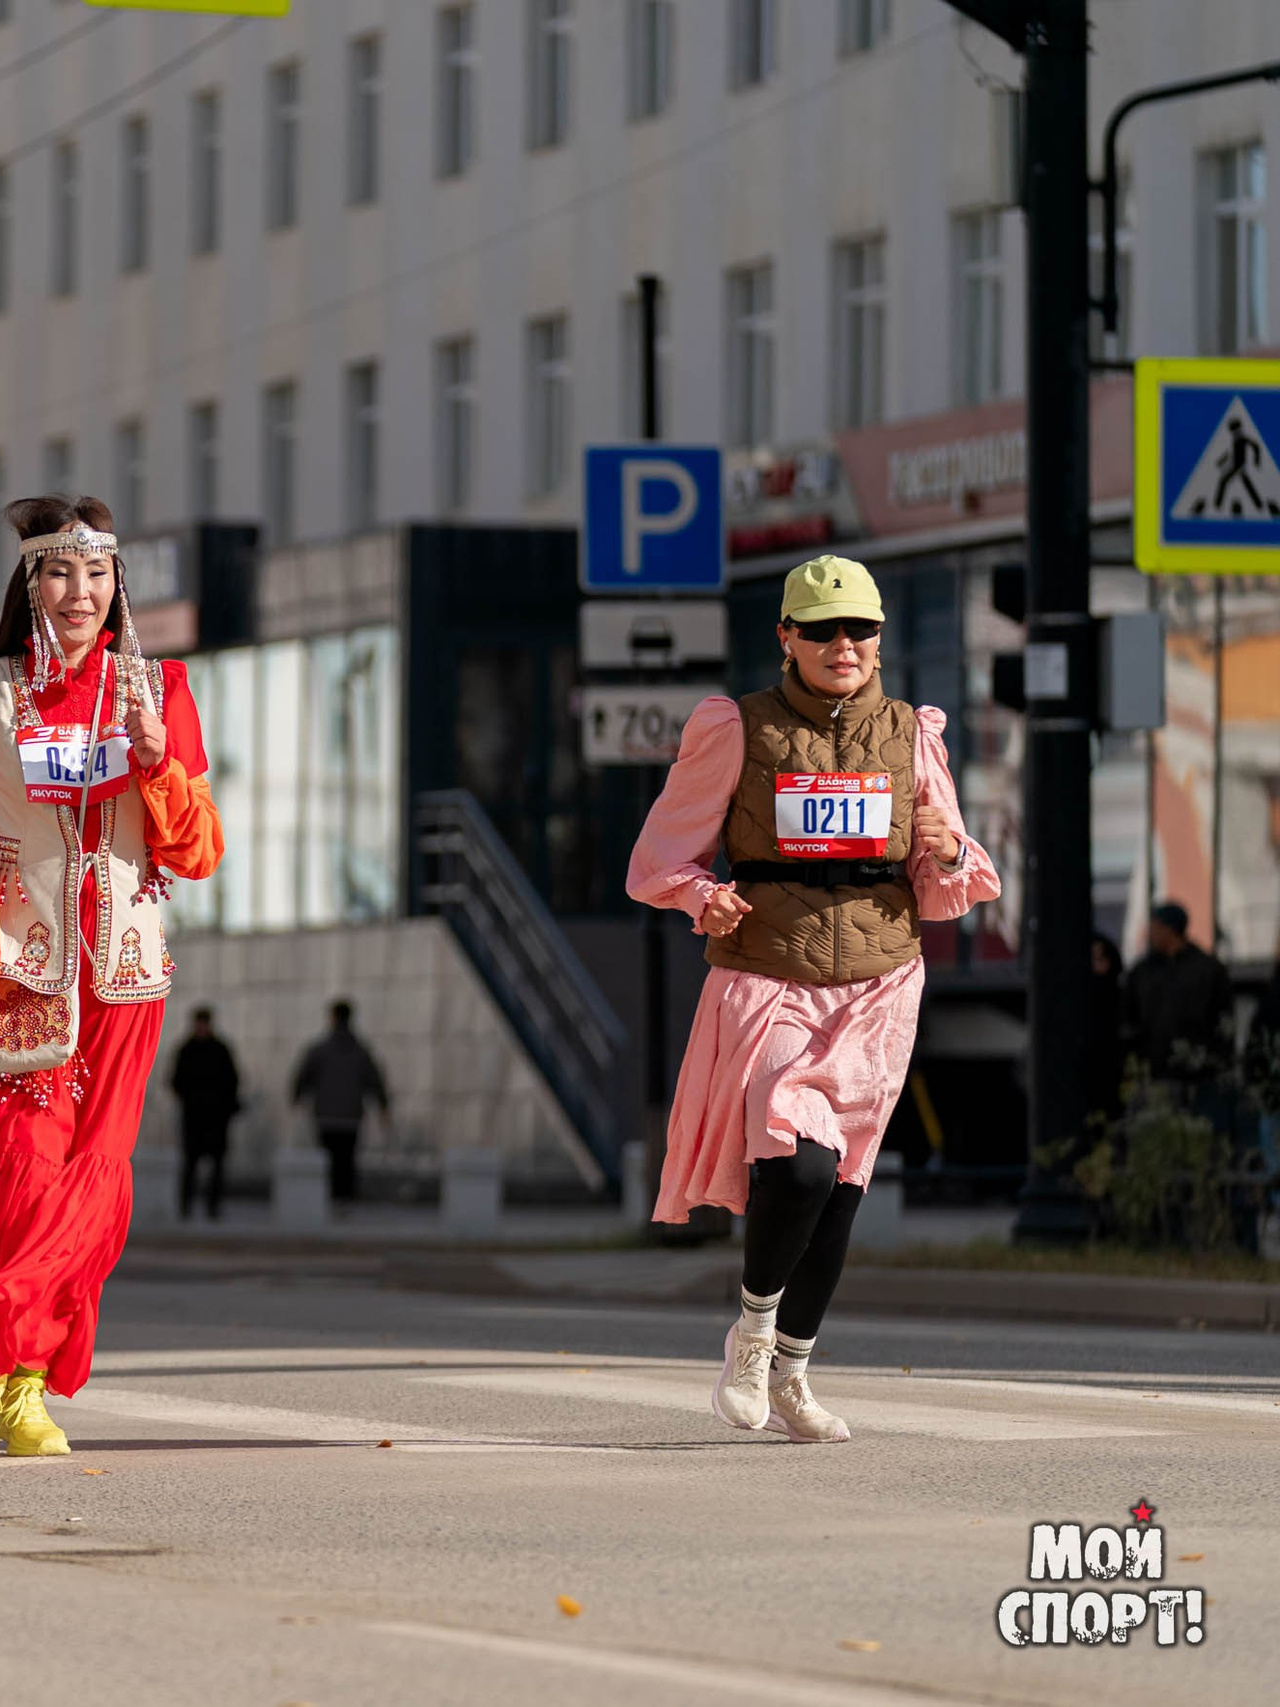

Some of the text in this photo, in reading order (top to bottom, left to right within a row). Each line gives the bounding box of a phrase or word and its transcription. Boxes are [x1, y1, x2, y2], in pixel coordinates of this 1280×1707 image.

[622, 459, 699, 575] P
[30, 789, 72, 800] ЯКУТСК
[803, 798, 865, 834] 0211
[783, 843, 829, 852] ЯКУТСК
